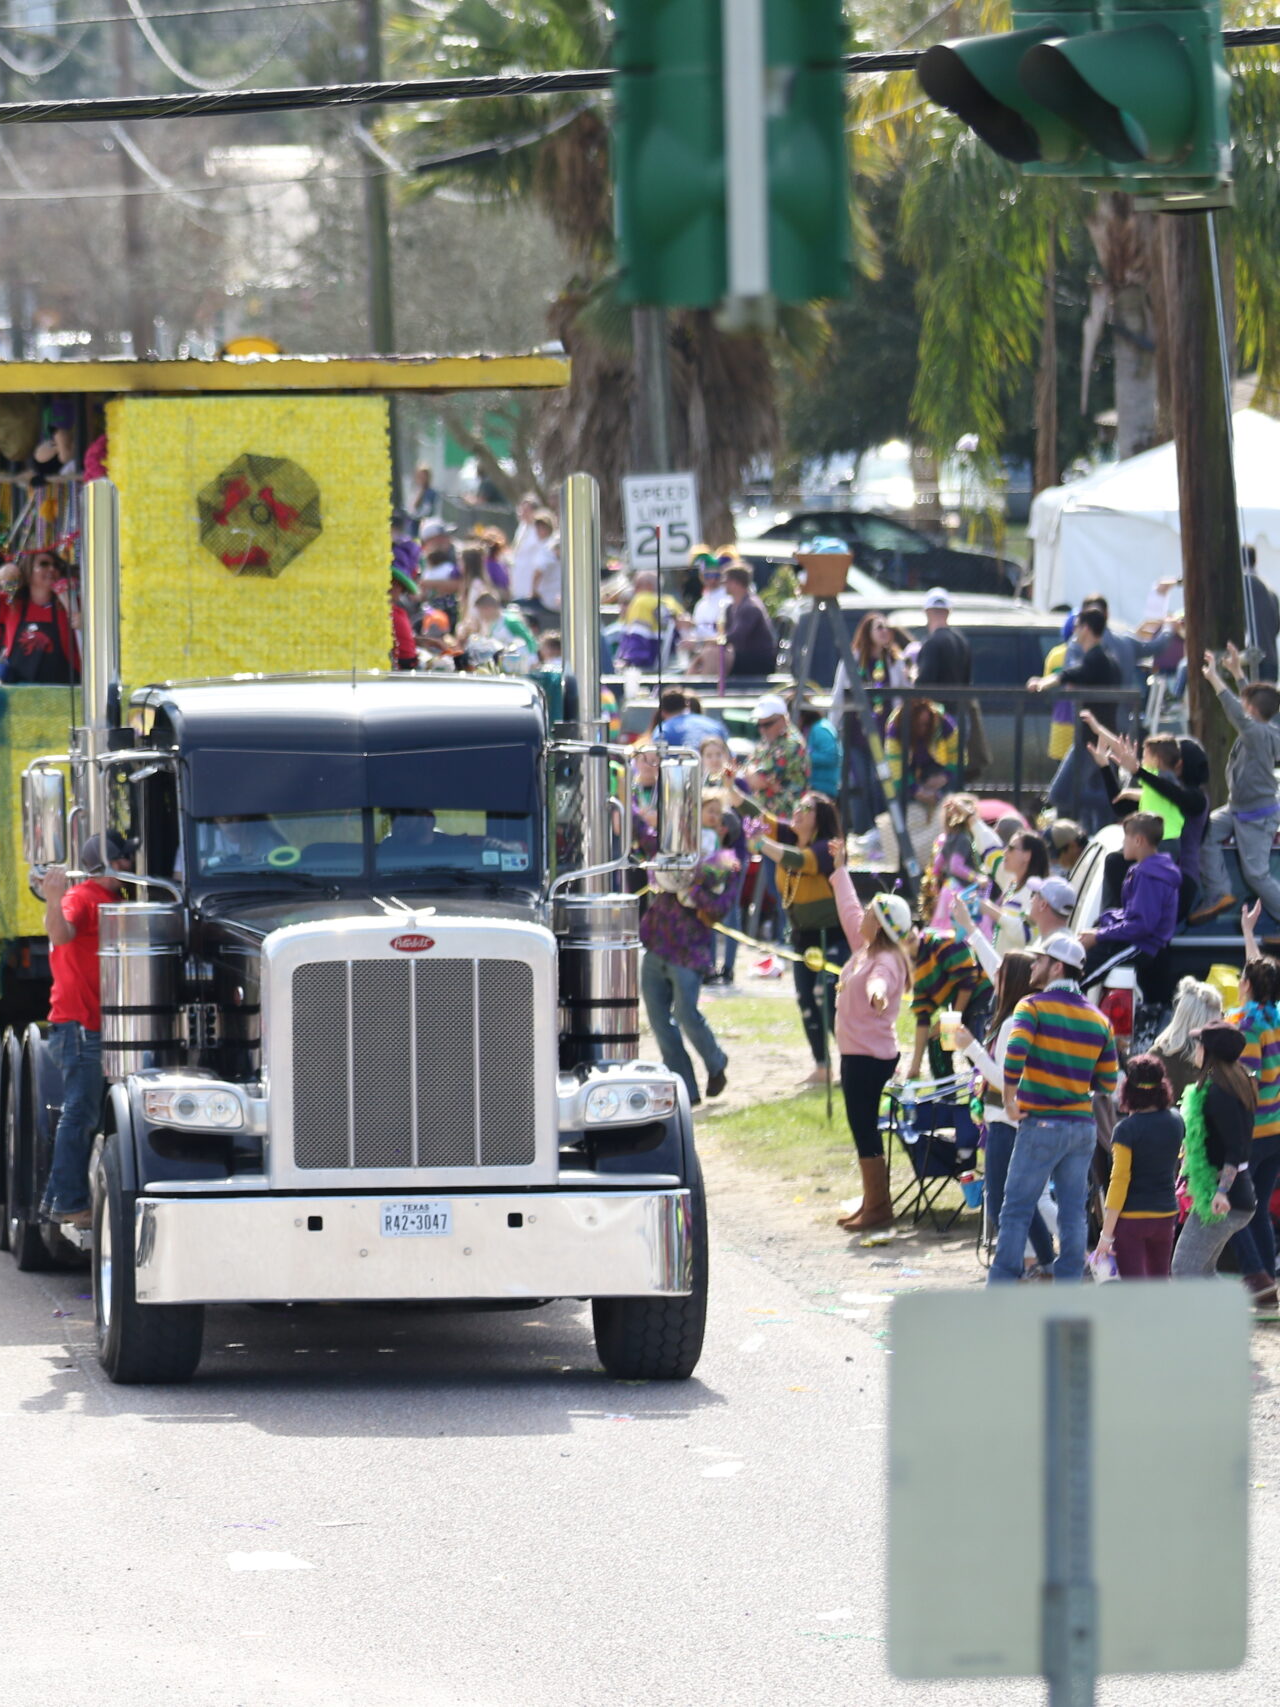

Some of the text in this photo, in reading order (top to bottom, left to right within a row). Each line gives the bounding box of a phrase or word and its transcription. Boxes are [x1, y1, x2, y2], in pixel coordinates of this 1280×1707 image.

[630, 486, 689, 502] SPEED
[637, 504, 683, 521] LIMIT
[636, 522, 691, 556] 25
[402, 1203, 430, 1212] TEXAS
